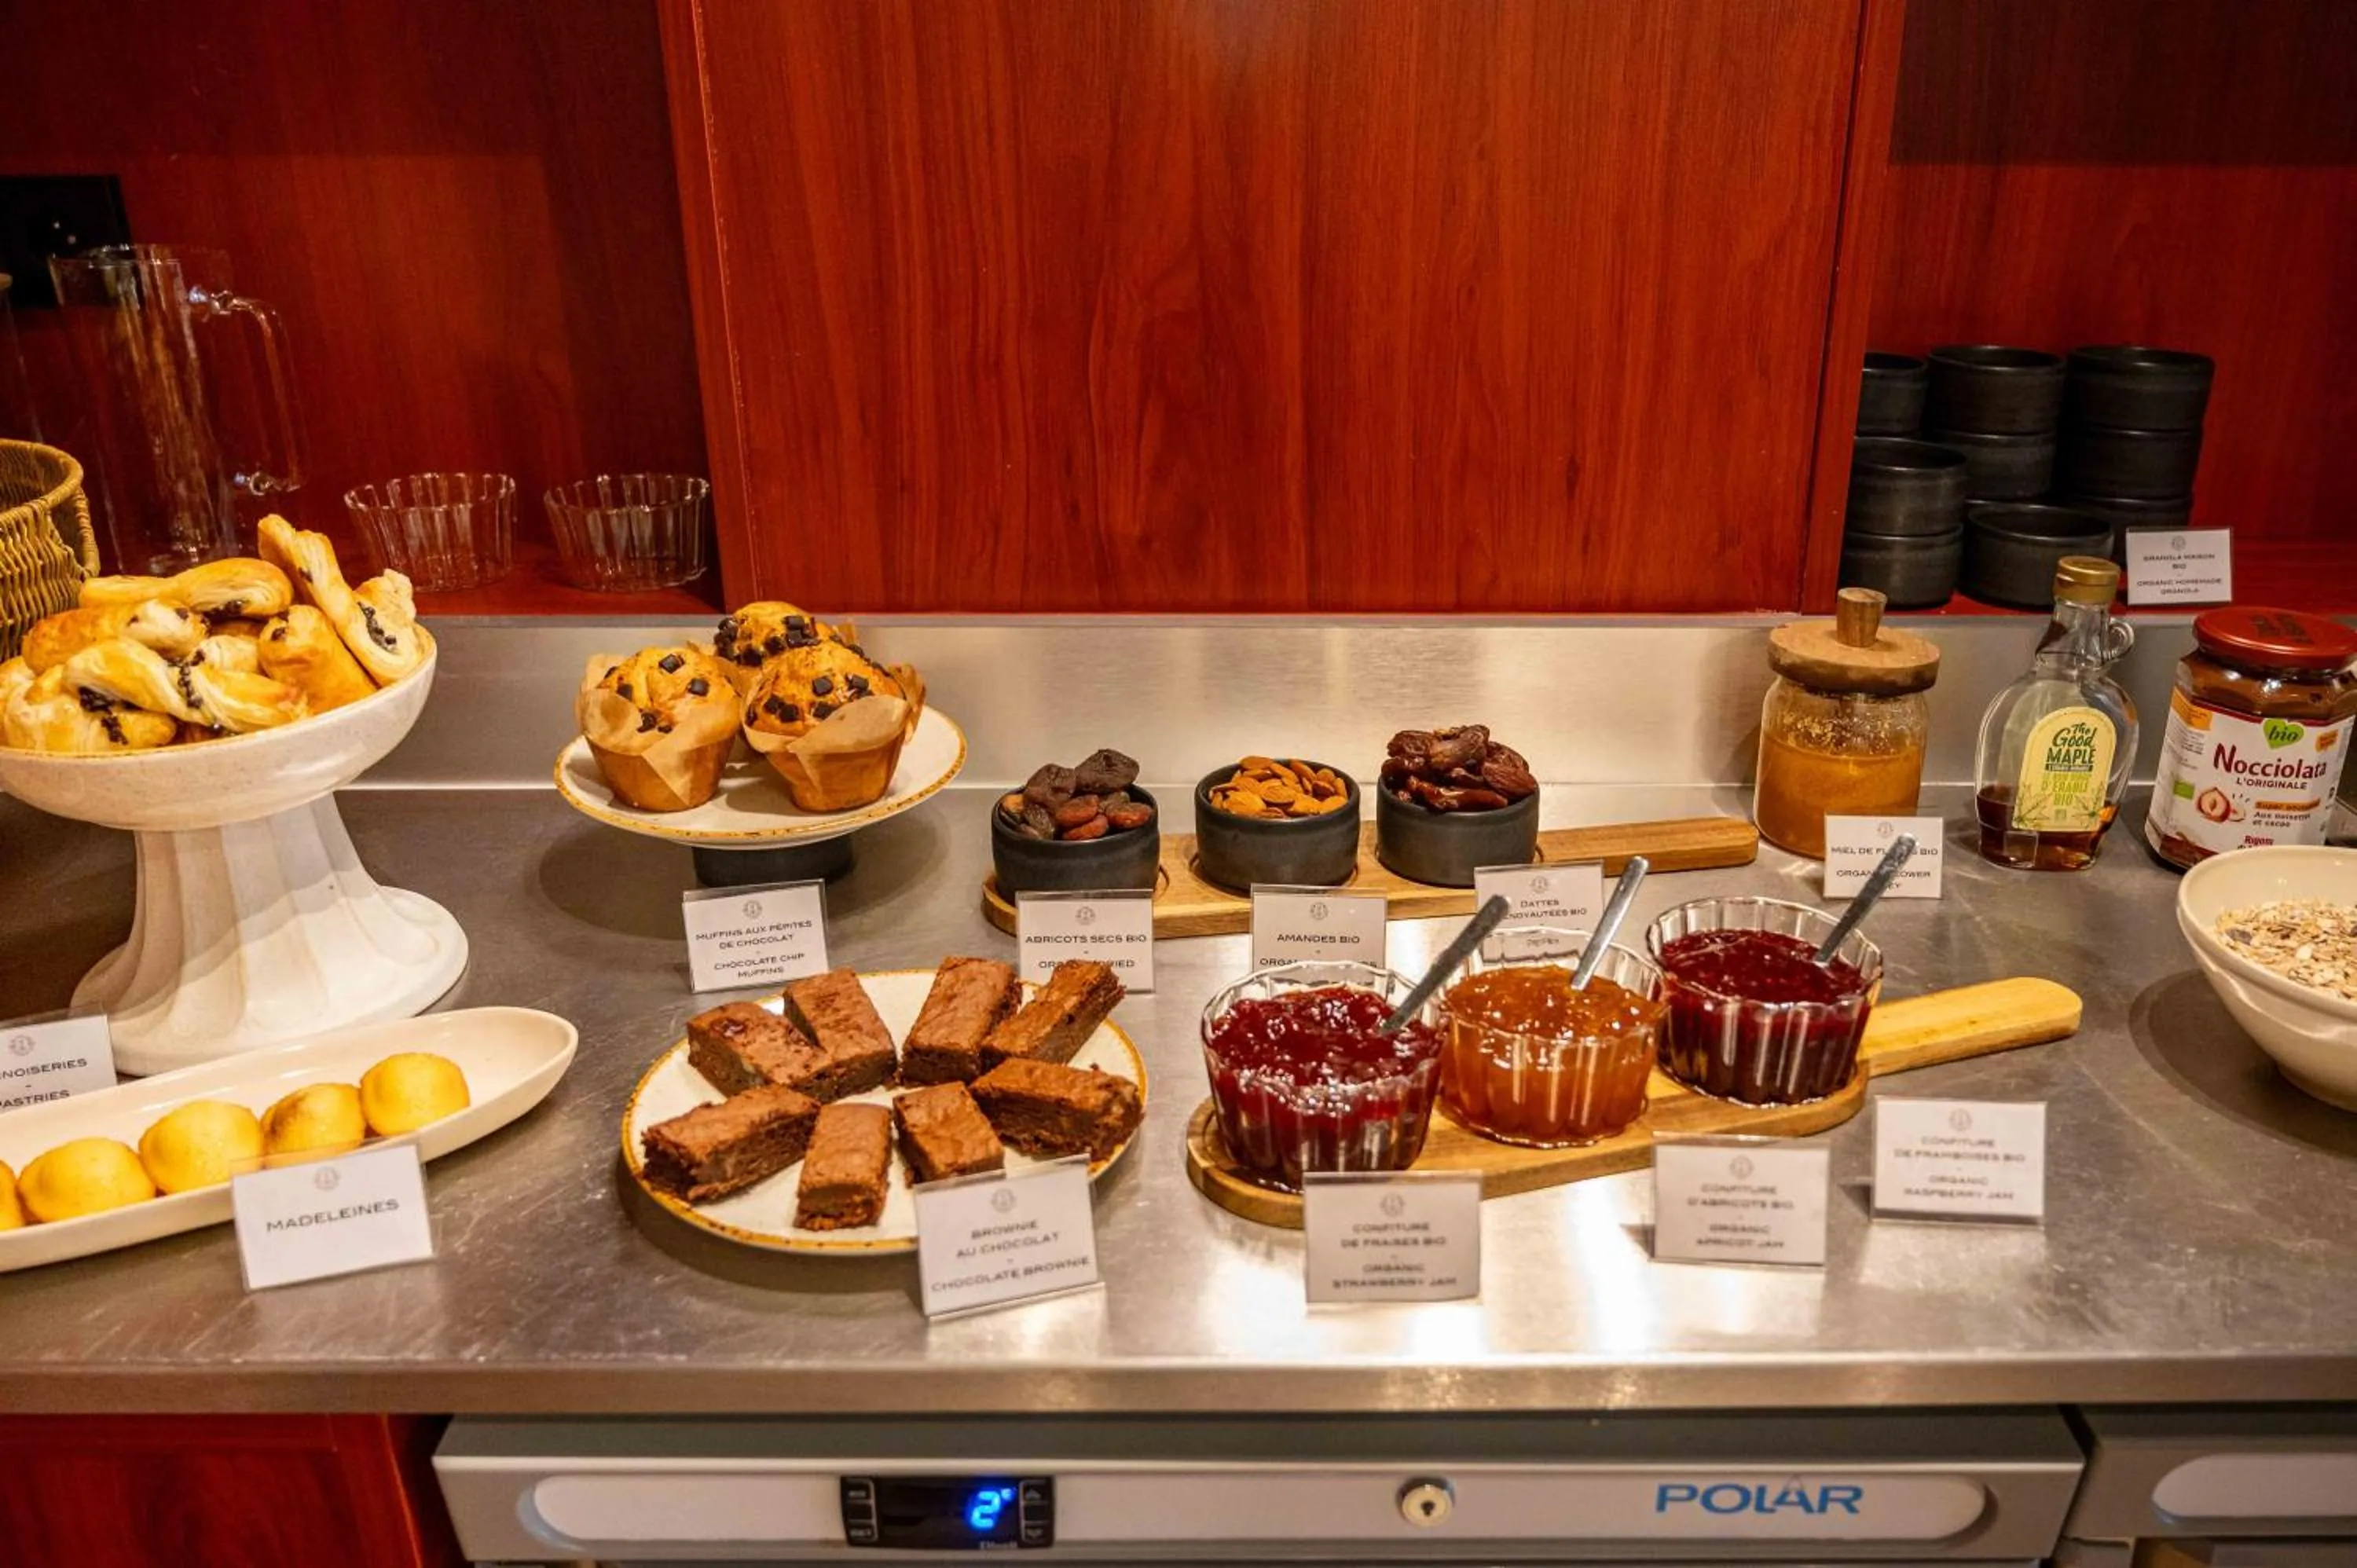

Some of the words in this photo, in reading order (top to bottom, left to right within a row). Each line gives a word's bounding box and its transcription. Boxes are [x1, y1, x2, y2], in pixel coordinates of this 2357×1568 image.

[2072, 722, 2091, 735] The
[2267, 725, 2299, 742] bio
[2052, 727, 2098, 747] Good
[2046, 747, 2097, 764] MAPLE
[2213, 742, 2327, 779] Nocciolata
[2236, 777, 2308, 790] L'ORIGINALE
[1520, 899, 1560, 907] DATTES
[1570, 907, 1587, 916] BIO
[696, 930, 742, 941] MUFFINS
[746, 926, 766, 936] AUX
[736, 934, 794, 947] CHOCOLAT
[1025, 935, 1088, 943] ABRICOTS
[1090, 935, 1123, 943] SECS
[1126, 934, 1147, 943] BIO
[1277, 934, 1336, 943] AMANDES
[714, 956, 777, 971] CHOCOLATE
[779, 953, 805, 962] CHIP
[1259, 958, 1298, 967] ORGA
[738, 966, 784, 979] MUFFINS
[0, 1058, 88, 1079] NOISERIES
[1893, 1149, 1912, 1158] DE
[2003, 1153, 2025, 1162] BIO
[266, 1198, 400, 1233] MADELEINES
[955, 1247, 977, 1258] AU
[981, 1230, 1060, 1255] CHOCOLAT
[1340, 1239, 1359, 1248] DE
[931, 1269, 1021, 1292] CHOCOLATE
[1655, 1477, 1864, 1515] POLAR
